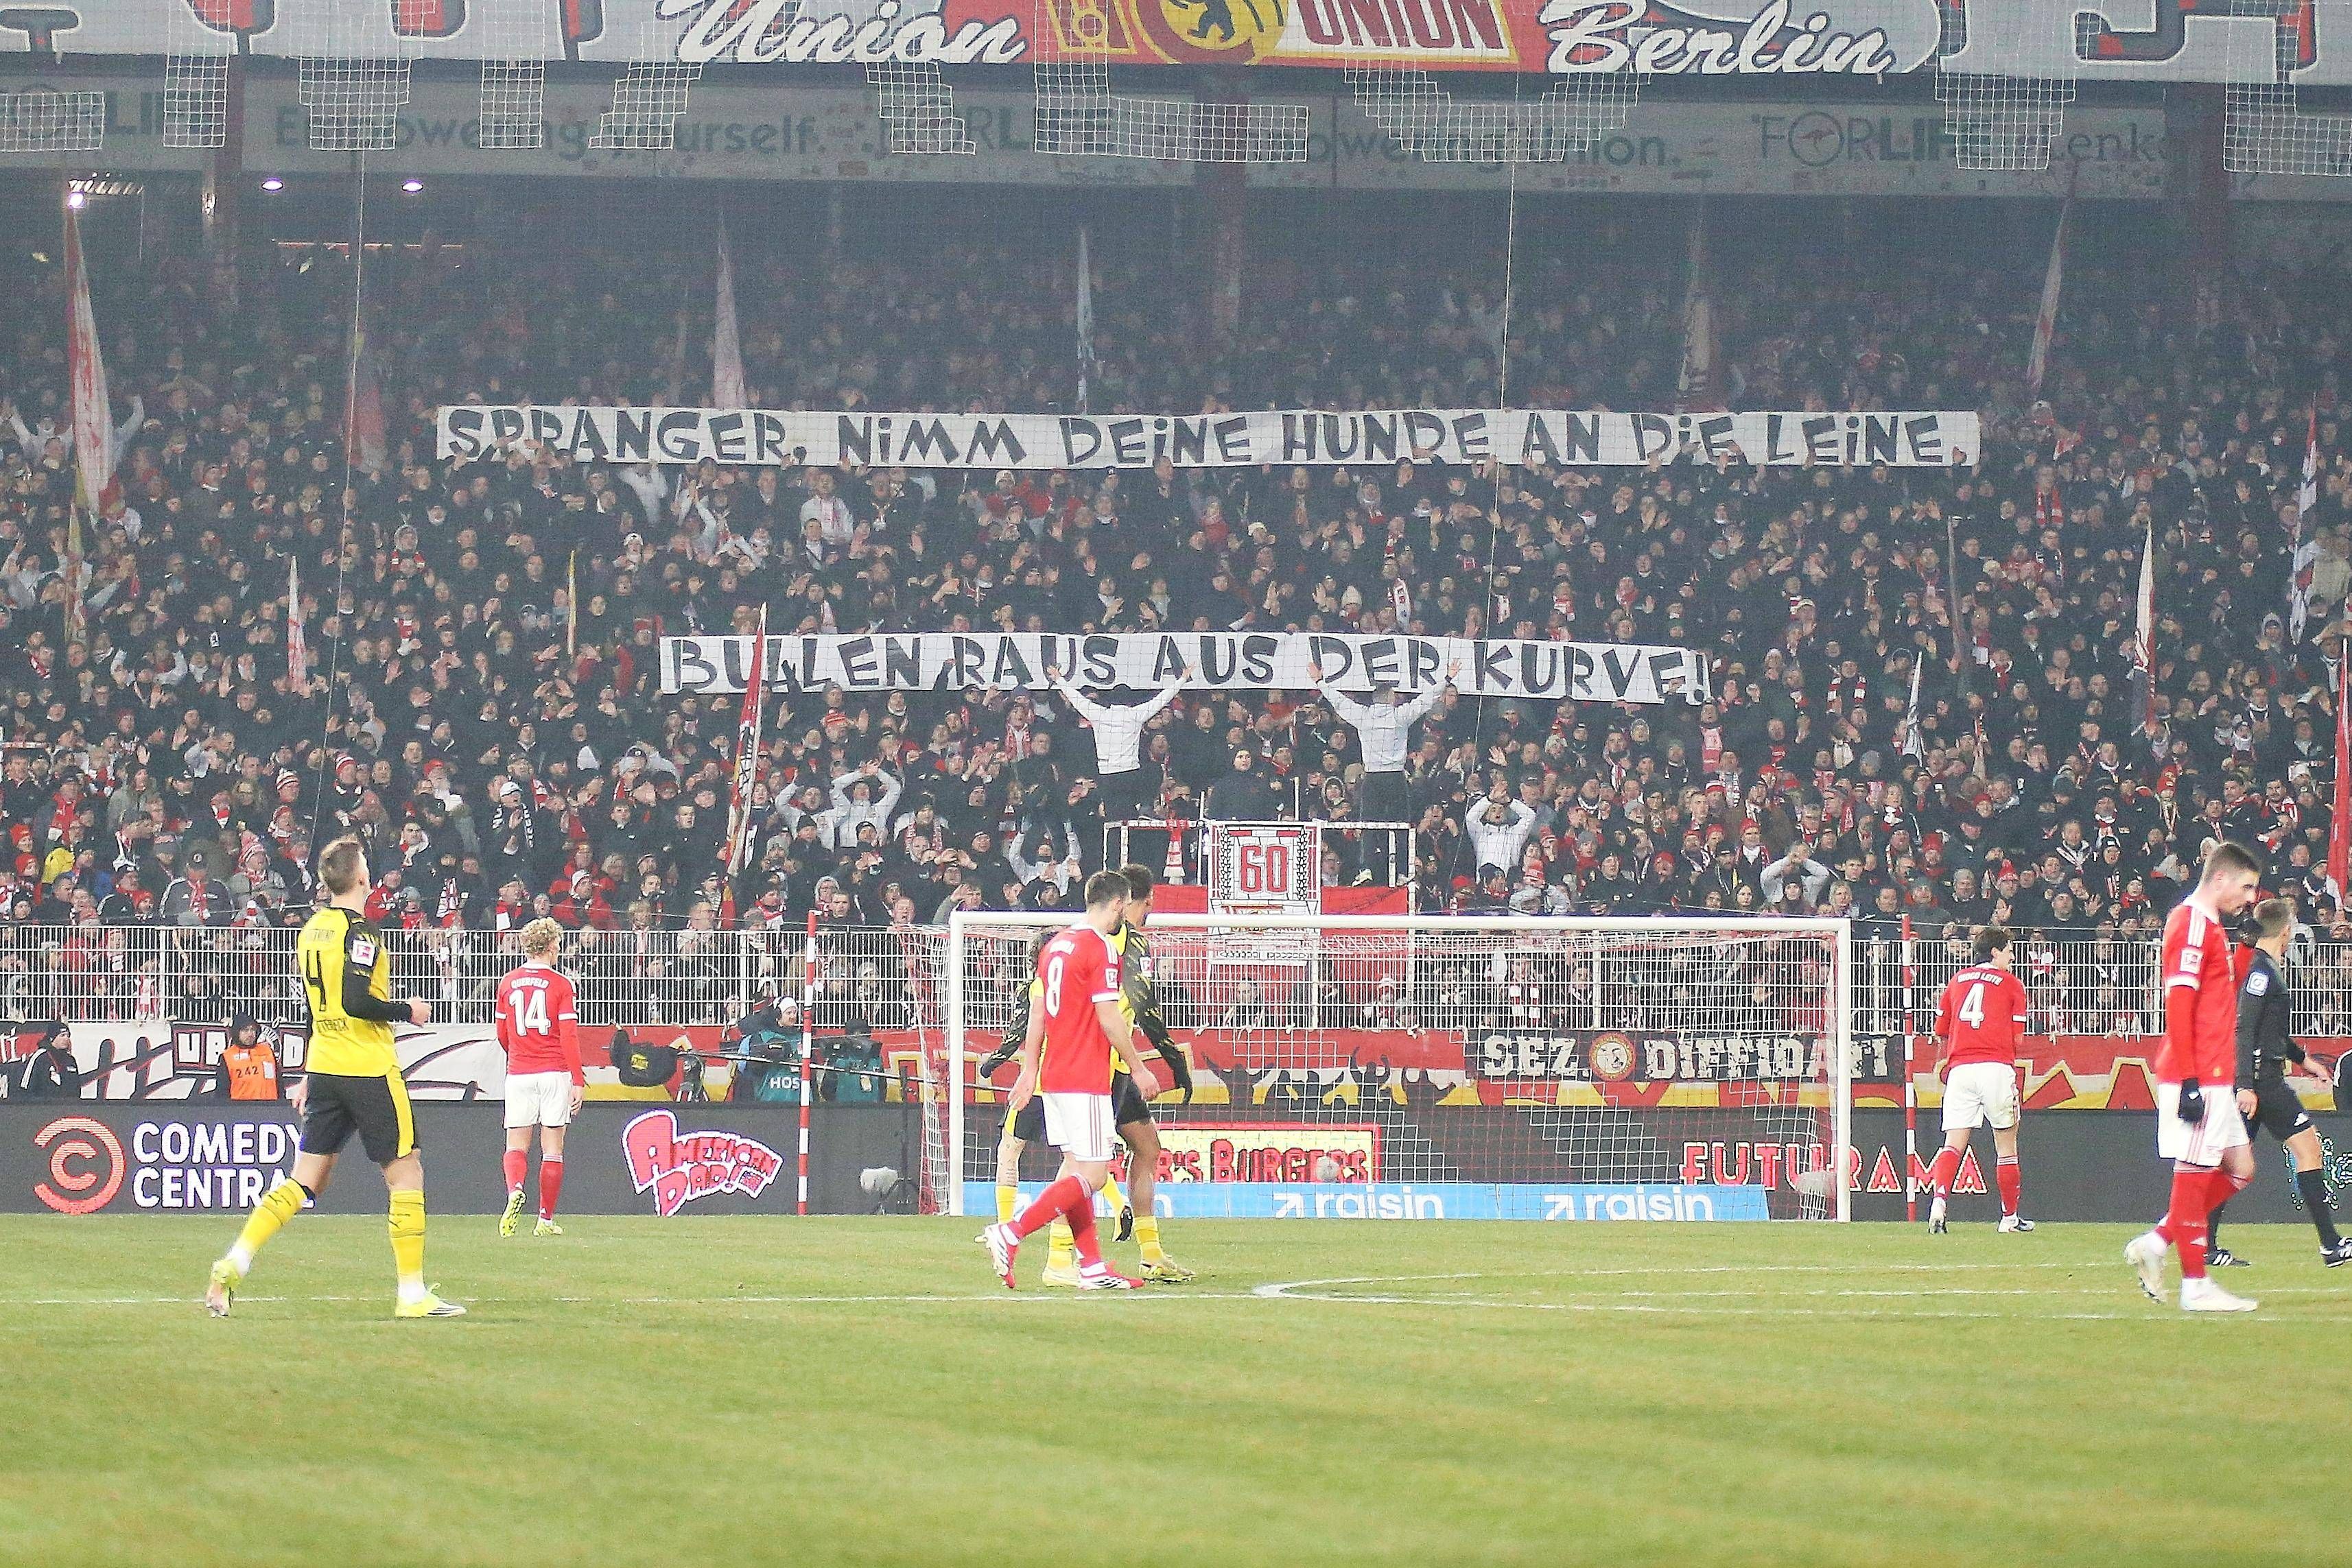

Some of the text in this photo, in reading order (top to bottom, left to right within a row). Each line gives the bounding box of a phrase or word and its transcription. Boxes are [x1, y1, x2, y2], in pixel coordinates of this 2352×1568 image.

[657, 0, 1027, 63] Union
[1539, 0, 1897, 74] Berlin
[448, 409, 808, 463] SPRANGER,
[1282, 412, 1489, 462] HUNDE
[1522, 413, 1600, 462] AN
[672, 634, 1705, 704] BULLEN RAUS AUS DER KURVE!
[1240, 844, 1289, 893] 60
[306, 949, 327, 1012] 4
[1046, 955, 1066, 1019] 8
[508, 988, 552, 1036] 14
[1958, 982, 1986, 1030] 4
[235, 1066, 259, 1078] 242
[1483, 1034, 1590, 1078] SEZ.
[769, 1077, 802, 1090] HOS
[133, 1122, 301, 1165] COMEDY
[626, 1115, 777, 1187] AMERICAN
[1316, 1186, 1442, 1220] raisin
[1585, 1186, 1714, 1222] raisin
